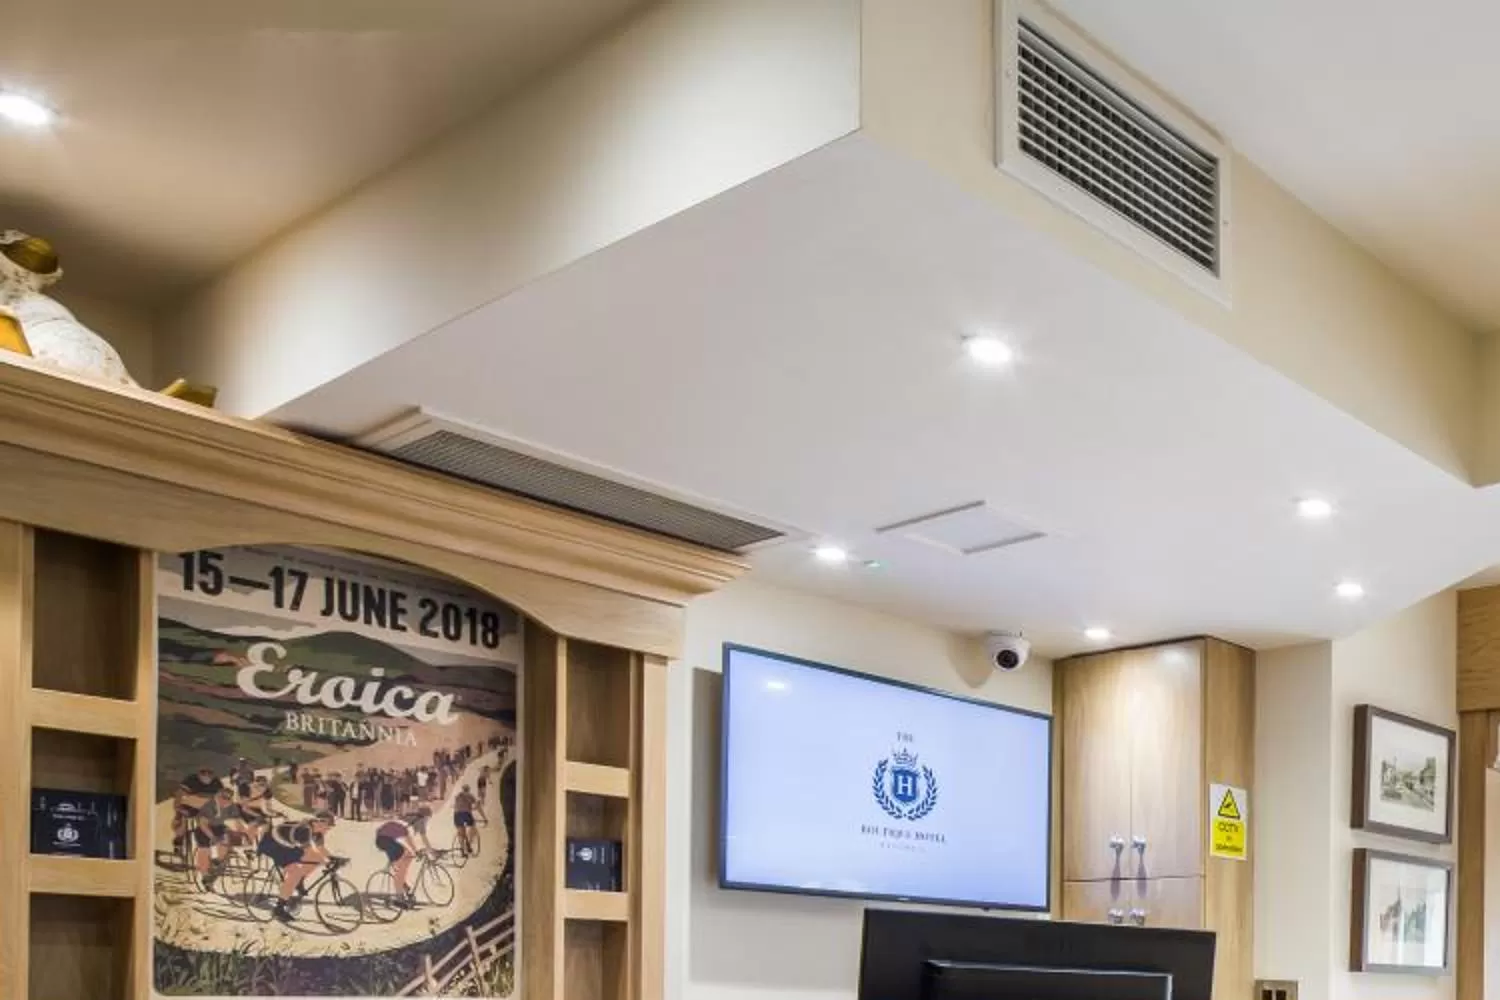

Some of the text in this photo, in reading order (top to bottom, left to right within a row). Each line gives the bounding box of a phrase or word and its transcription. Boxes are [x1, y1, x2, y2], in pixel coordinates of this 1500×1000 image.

[320, 577, 408, 632] JUNE
[419, 598, 500, 648] 2018
[237, 642, 459, 725] Eroica
[286, 711, 418, 748] BRITANNIA
[895, 775, 914, 797] H
